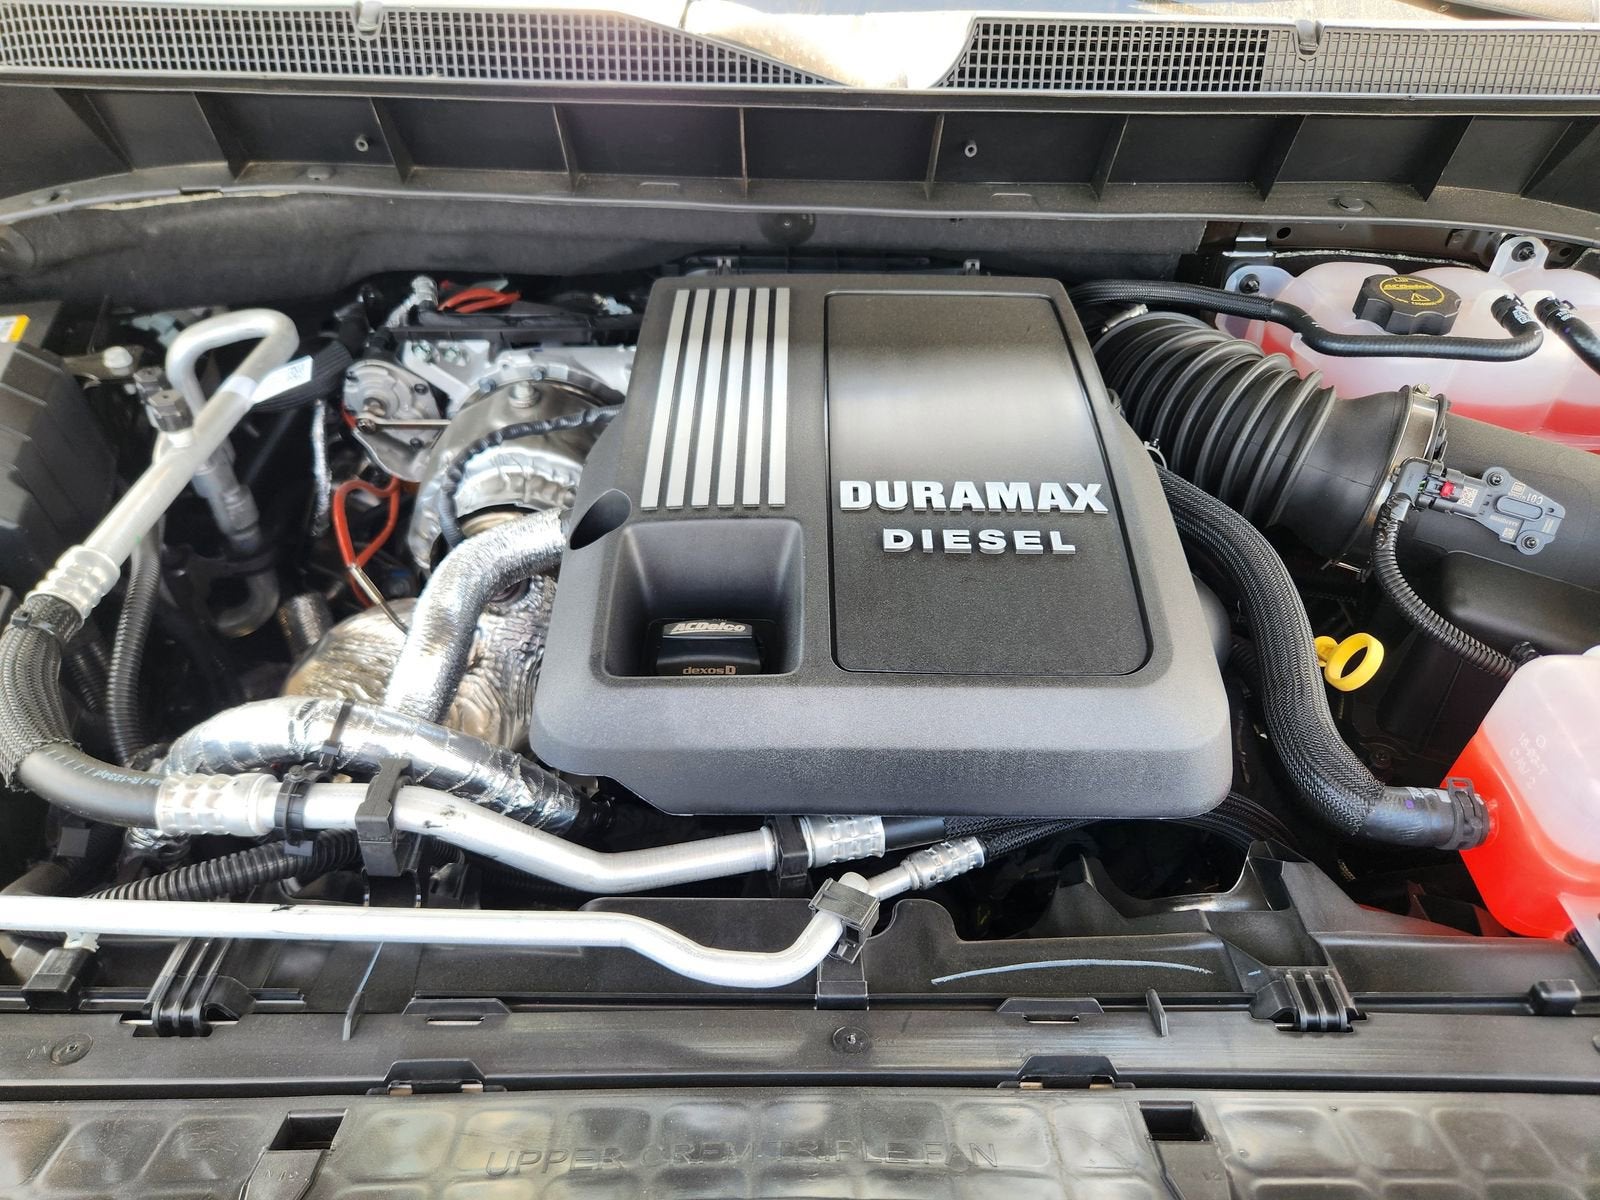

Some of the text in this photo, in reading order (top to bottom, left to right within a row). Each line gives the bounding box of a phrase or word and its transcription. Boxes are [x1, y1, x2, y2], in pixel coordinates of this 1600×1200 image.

[840, 480, 1108, 514] DURAMAX
[883, 528, 1076, 555] DIESEL
[670, 622, 746, 635] ACDelco
[485, 1147, 625, 1176] UPPER
[767, 1140, 909, 1164] TRIPLE
[922, 1142, 998, 1168] FAN
